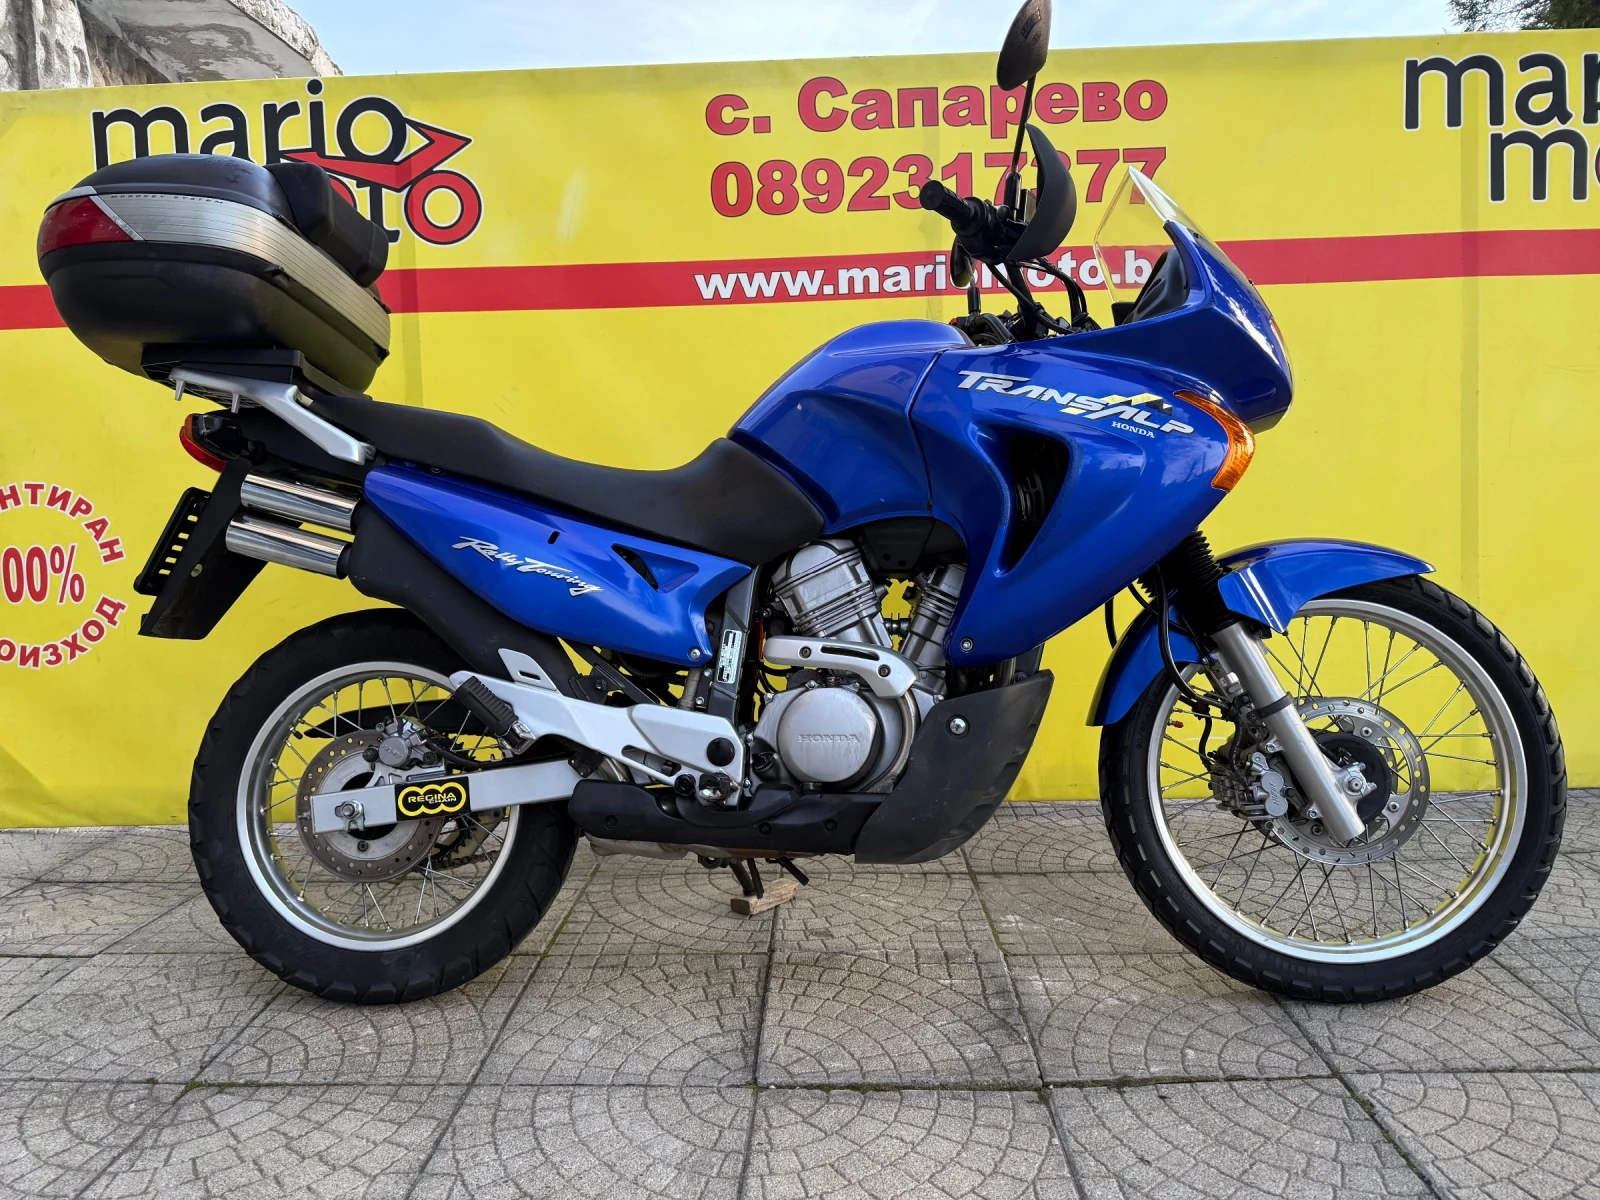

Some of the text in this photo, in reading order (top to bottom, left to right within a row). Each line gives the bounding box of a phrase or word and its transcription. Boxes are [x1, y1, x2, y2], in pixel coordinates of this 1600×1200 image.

[93, 78, 406, 171] mario
[705, 76, 1168, 139] с. Сапарево
[693, 248, 1154, 300] www.marioto.b
[957, 370, 1195, 434] TRANSALP
[1111, 420, 1155, 439] HONDA
[2, 545, 85, 603] 00%
[452, 536, 604, 596] Rally Touring
[797, 733, 861, 743] HONDA
[408, 792, 456, 803] REGINA
